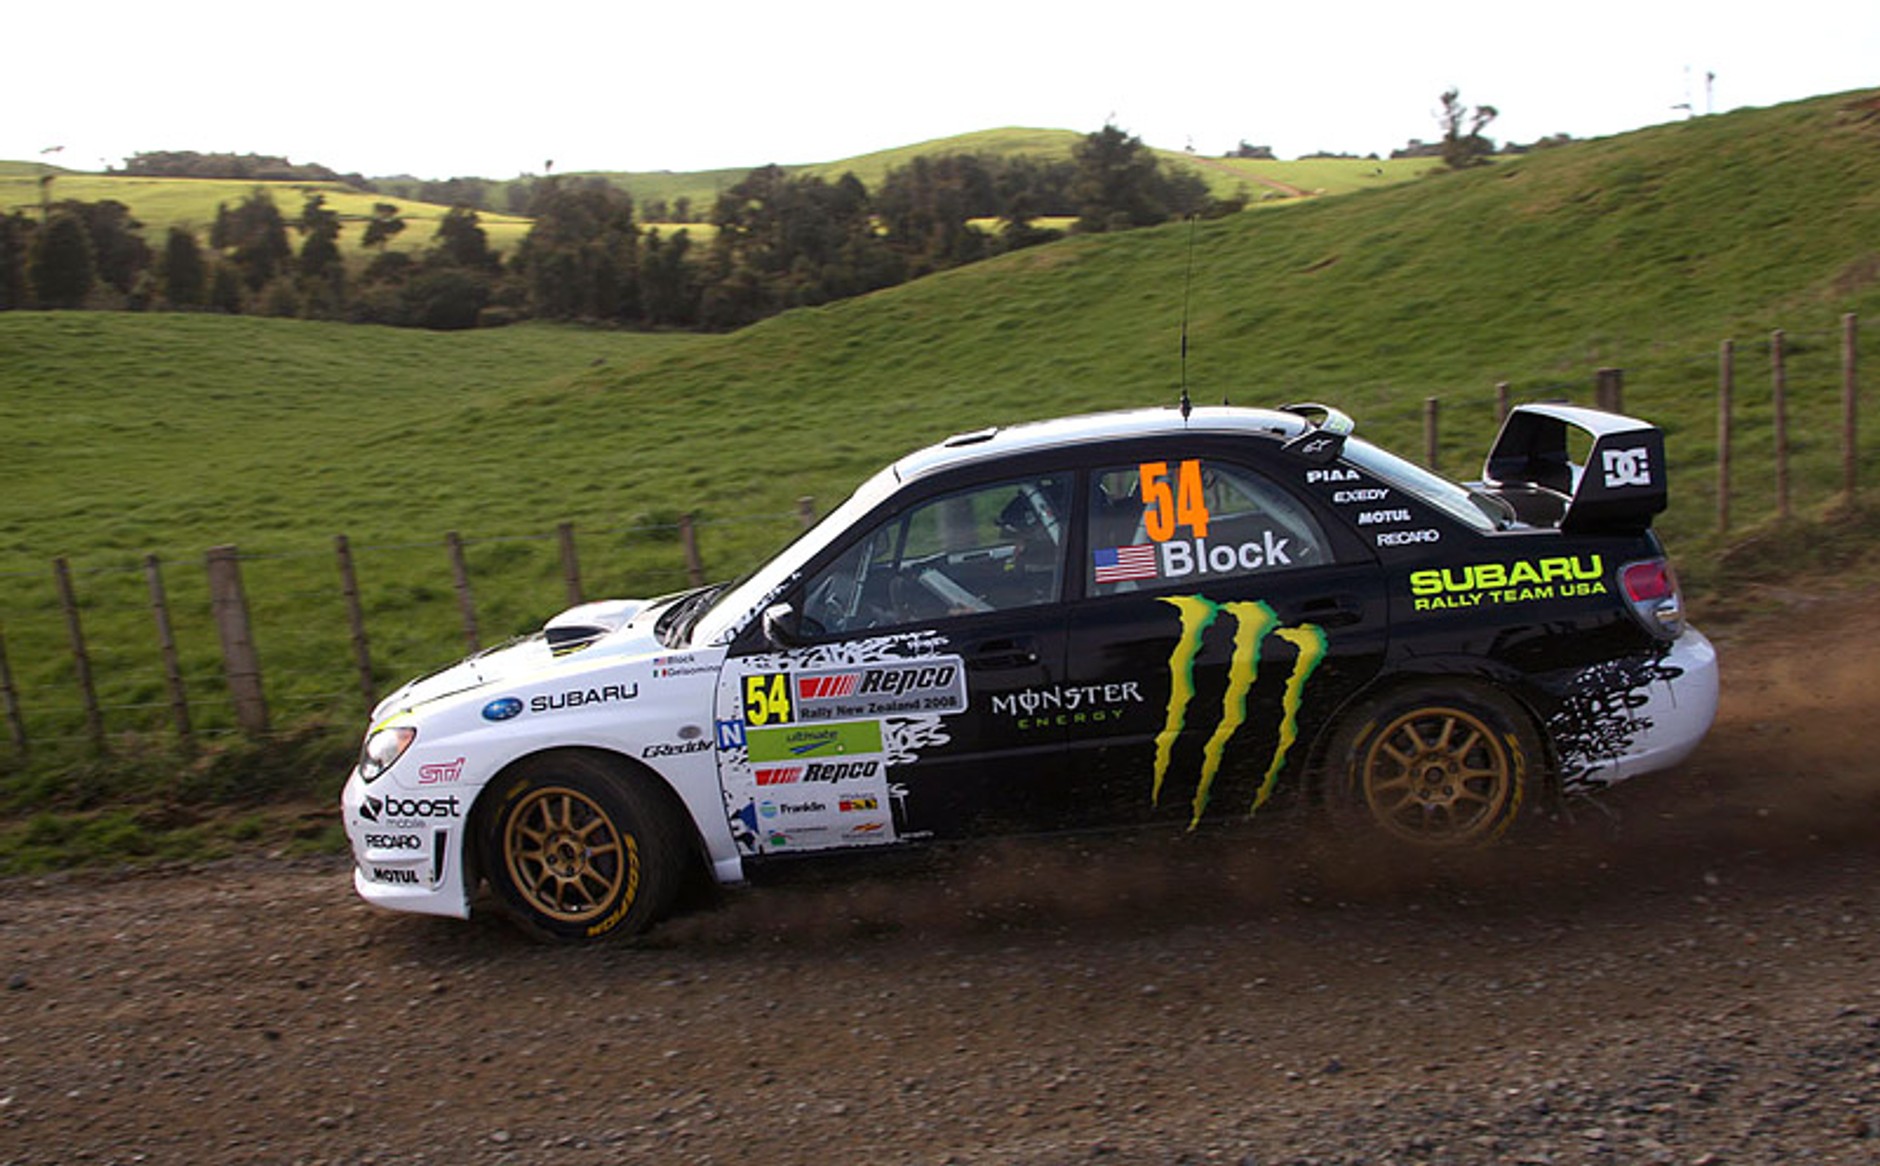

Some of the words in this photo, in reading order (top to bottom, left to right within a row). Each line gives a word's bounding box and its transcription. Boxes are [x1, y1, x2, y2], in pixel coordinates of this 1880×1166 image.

[1306, 469, 1360, 483] PIAA
[1139, 459, 1210, 542] 54
[1333, 488, 1390, 502] EXEDY
[1358, 508, 1411, 525] MOTUL
[1377, 529, 1440, 546] RECARO
[1162, 530, 1292, 578] Block
[1410, 554, 1604, 596] SUBARU
[1414, 591, 1484, 611] RALLY
[1488, 586, 1552, 604] TEAM
[1560, 580, 1607, 598] USA
[859, 666, 956, 695] Repco
[530, 682, 640, 712] SUBARU
[746, 674, 790, 727] 54
[800, 705, 832, 720] Rally
[836, 704, 865, 717] New
[869, 699, 920, 714] Zealand
[924, 696, 957, 709] 2008
[991, 681, 1144, 716] MONSTER
[1018, 708, 1124, 730] ENERGY
[721, 722, 743, 747] N
[786, 729, 839, 743] ultimate
[803, 761, 880, 783] Repco
[385, 794, 461, 817] boost
[780, 801, 826, 814] Franklin
[364, 834, 422, 850] RECARO
[373, 867, 420, 883] MOTUL
